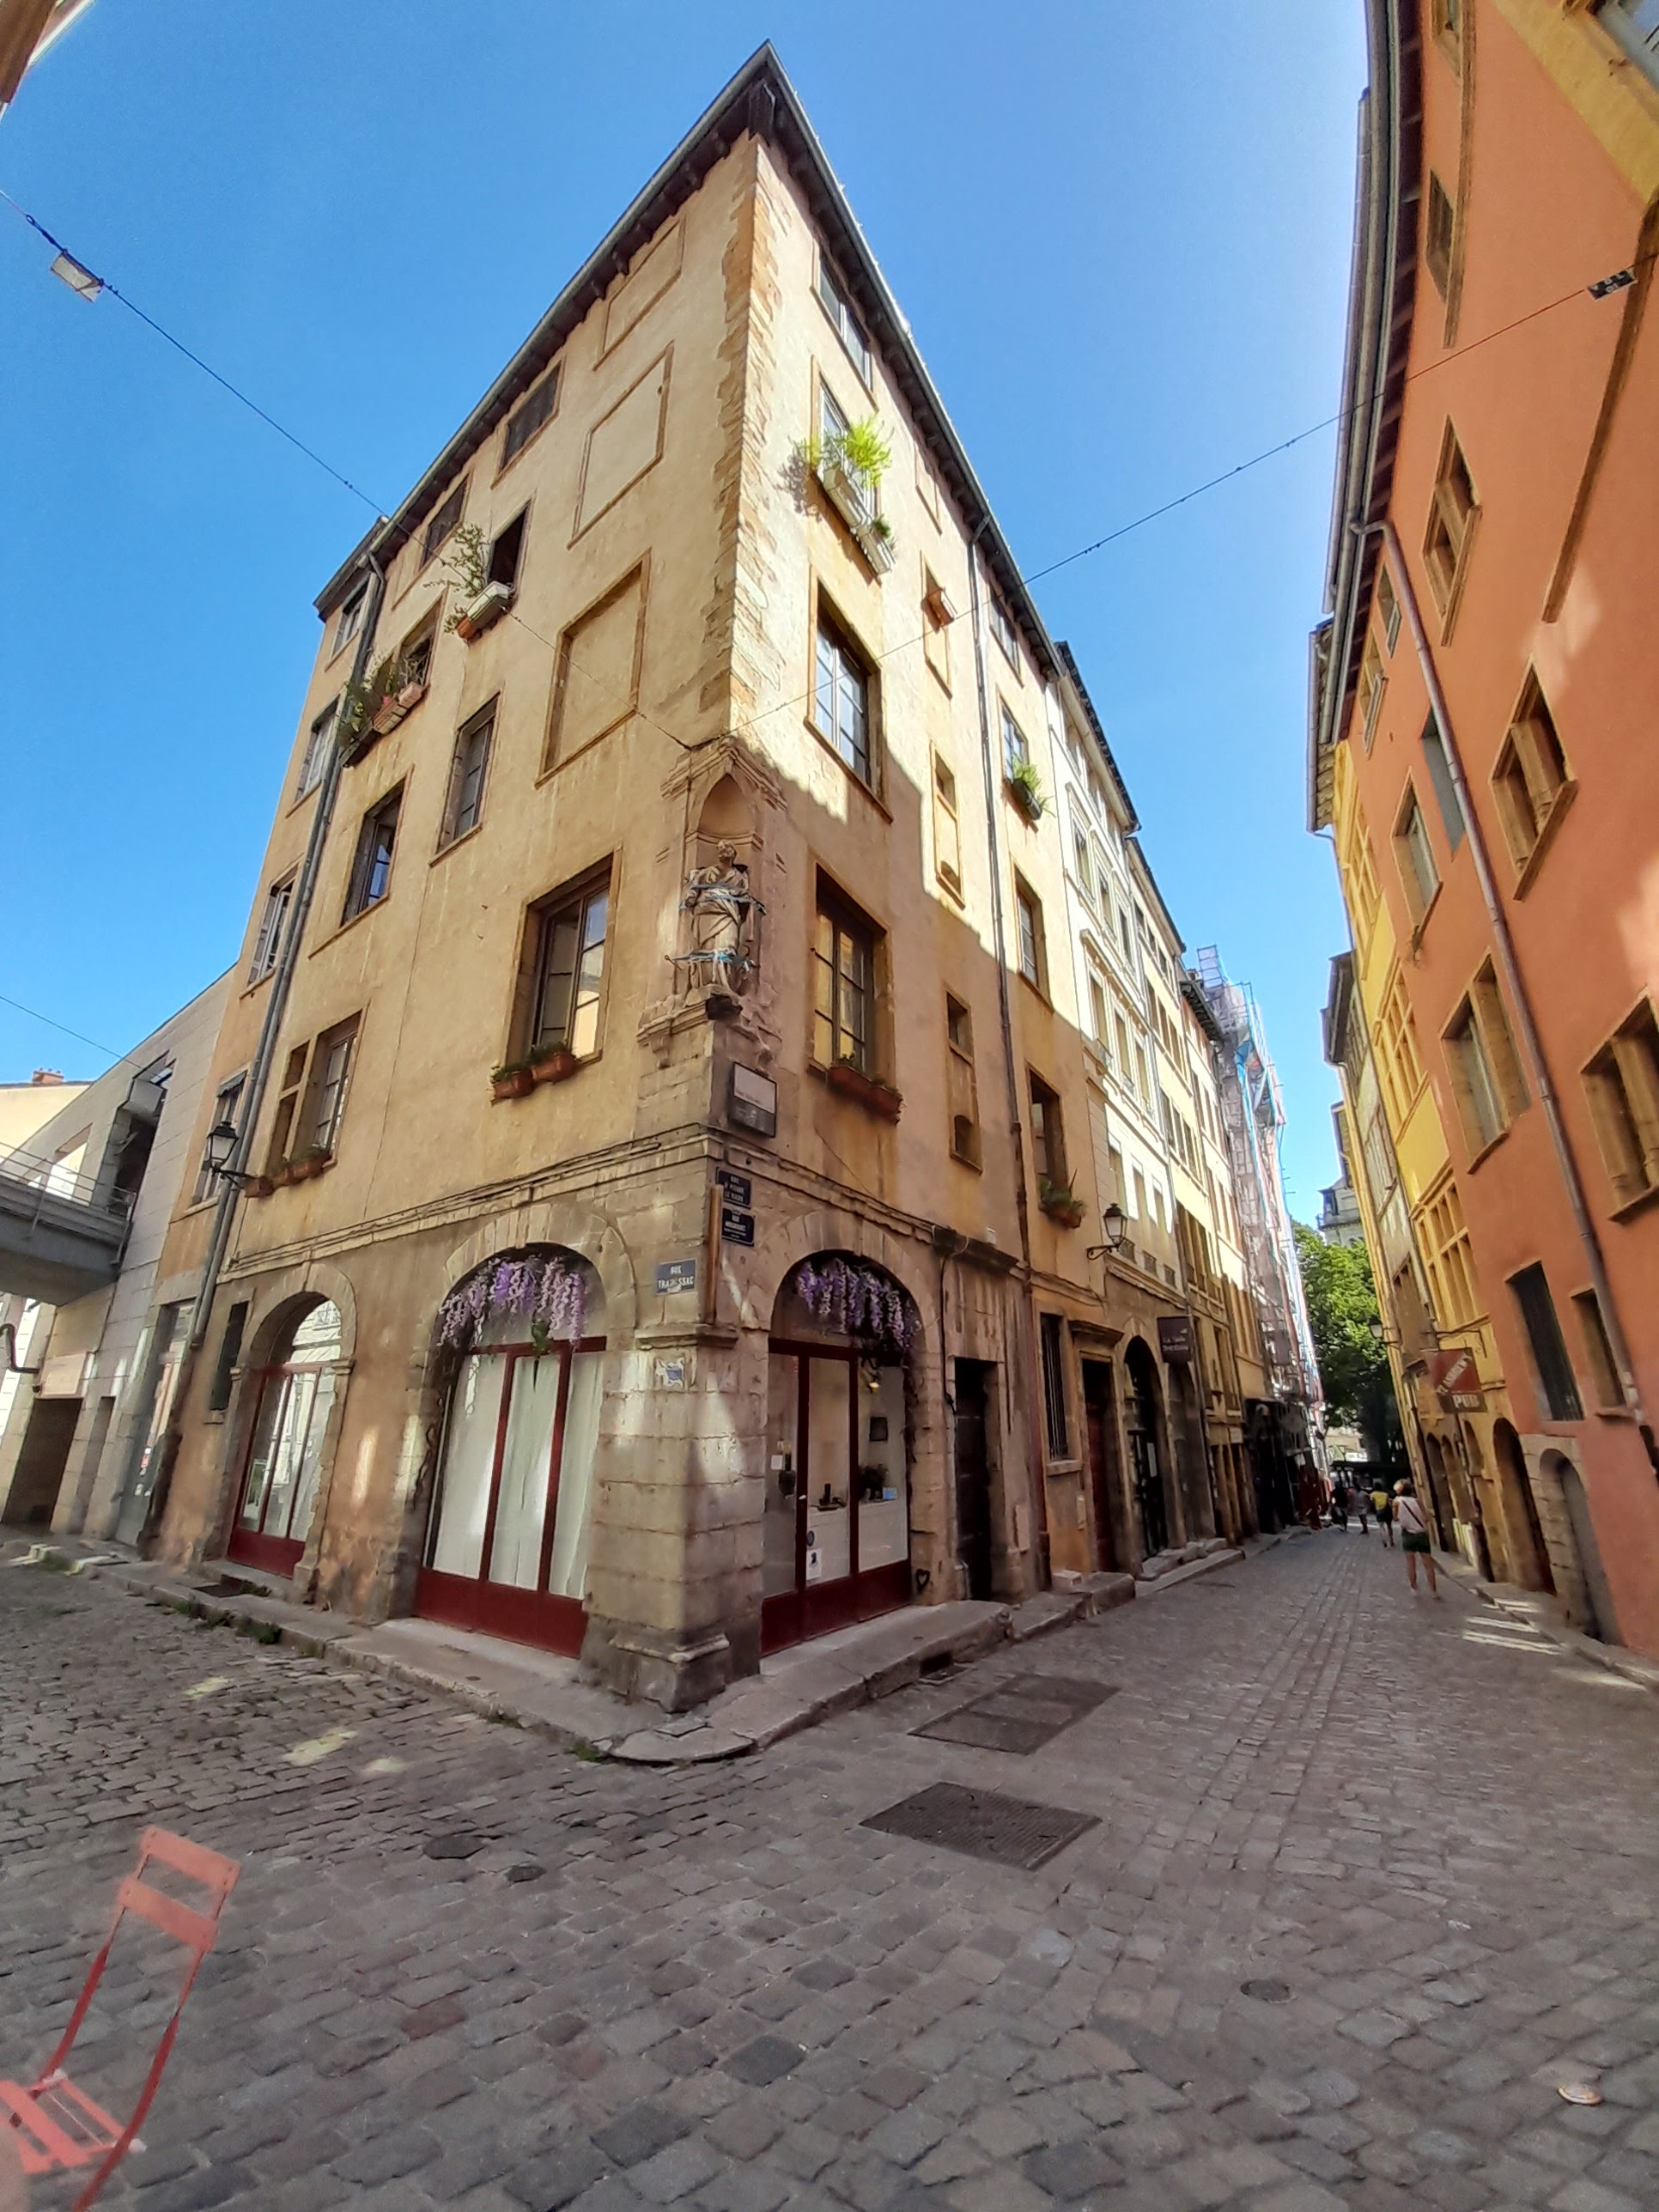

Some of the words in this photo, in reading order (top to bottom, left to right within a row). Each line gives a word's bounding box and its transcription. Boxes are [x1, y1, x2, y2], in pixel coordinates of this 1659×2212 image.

[671, 1265, 682, 1275] RUE
[658, 1275, 695, 1289] TRASSAC
[1452, 1394, 1480, 1407] PUB
